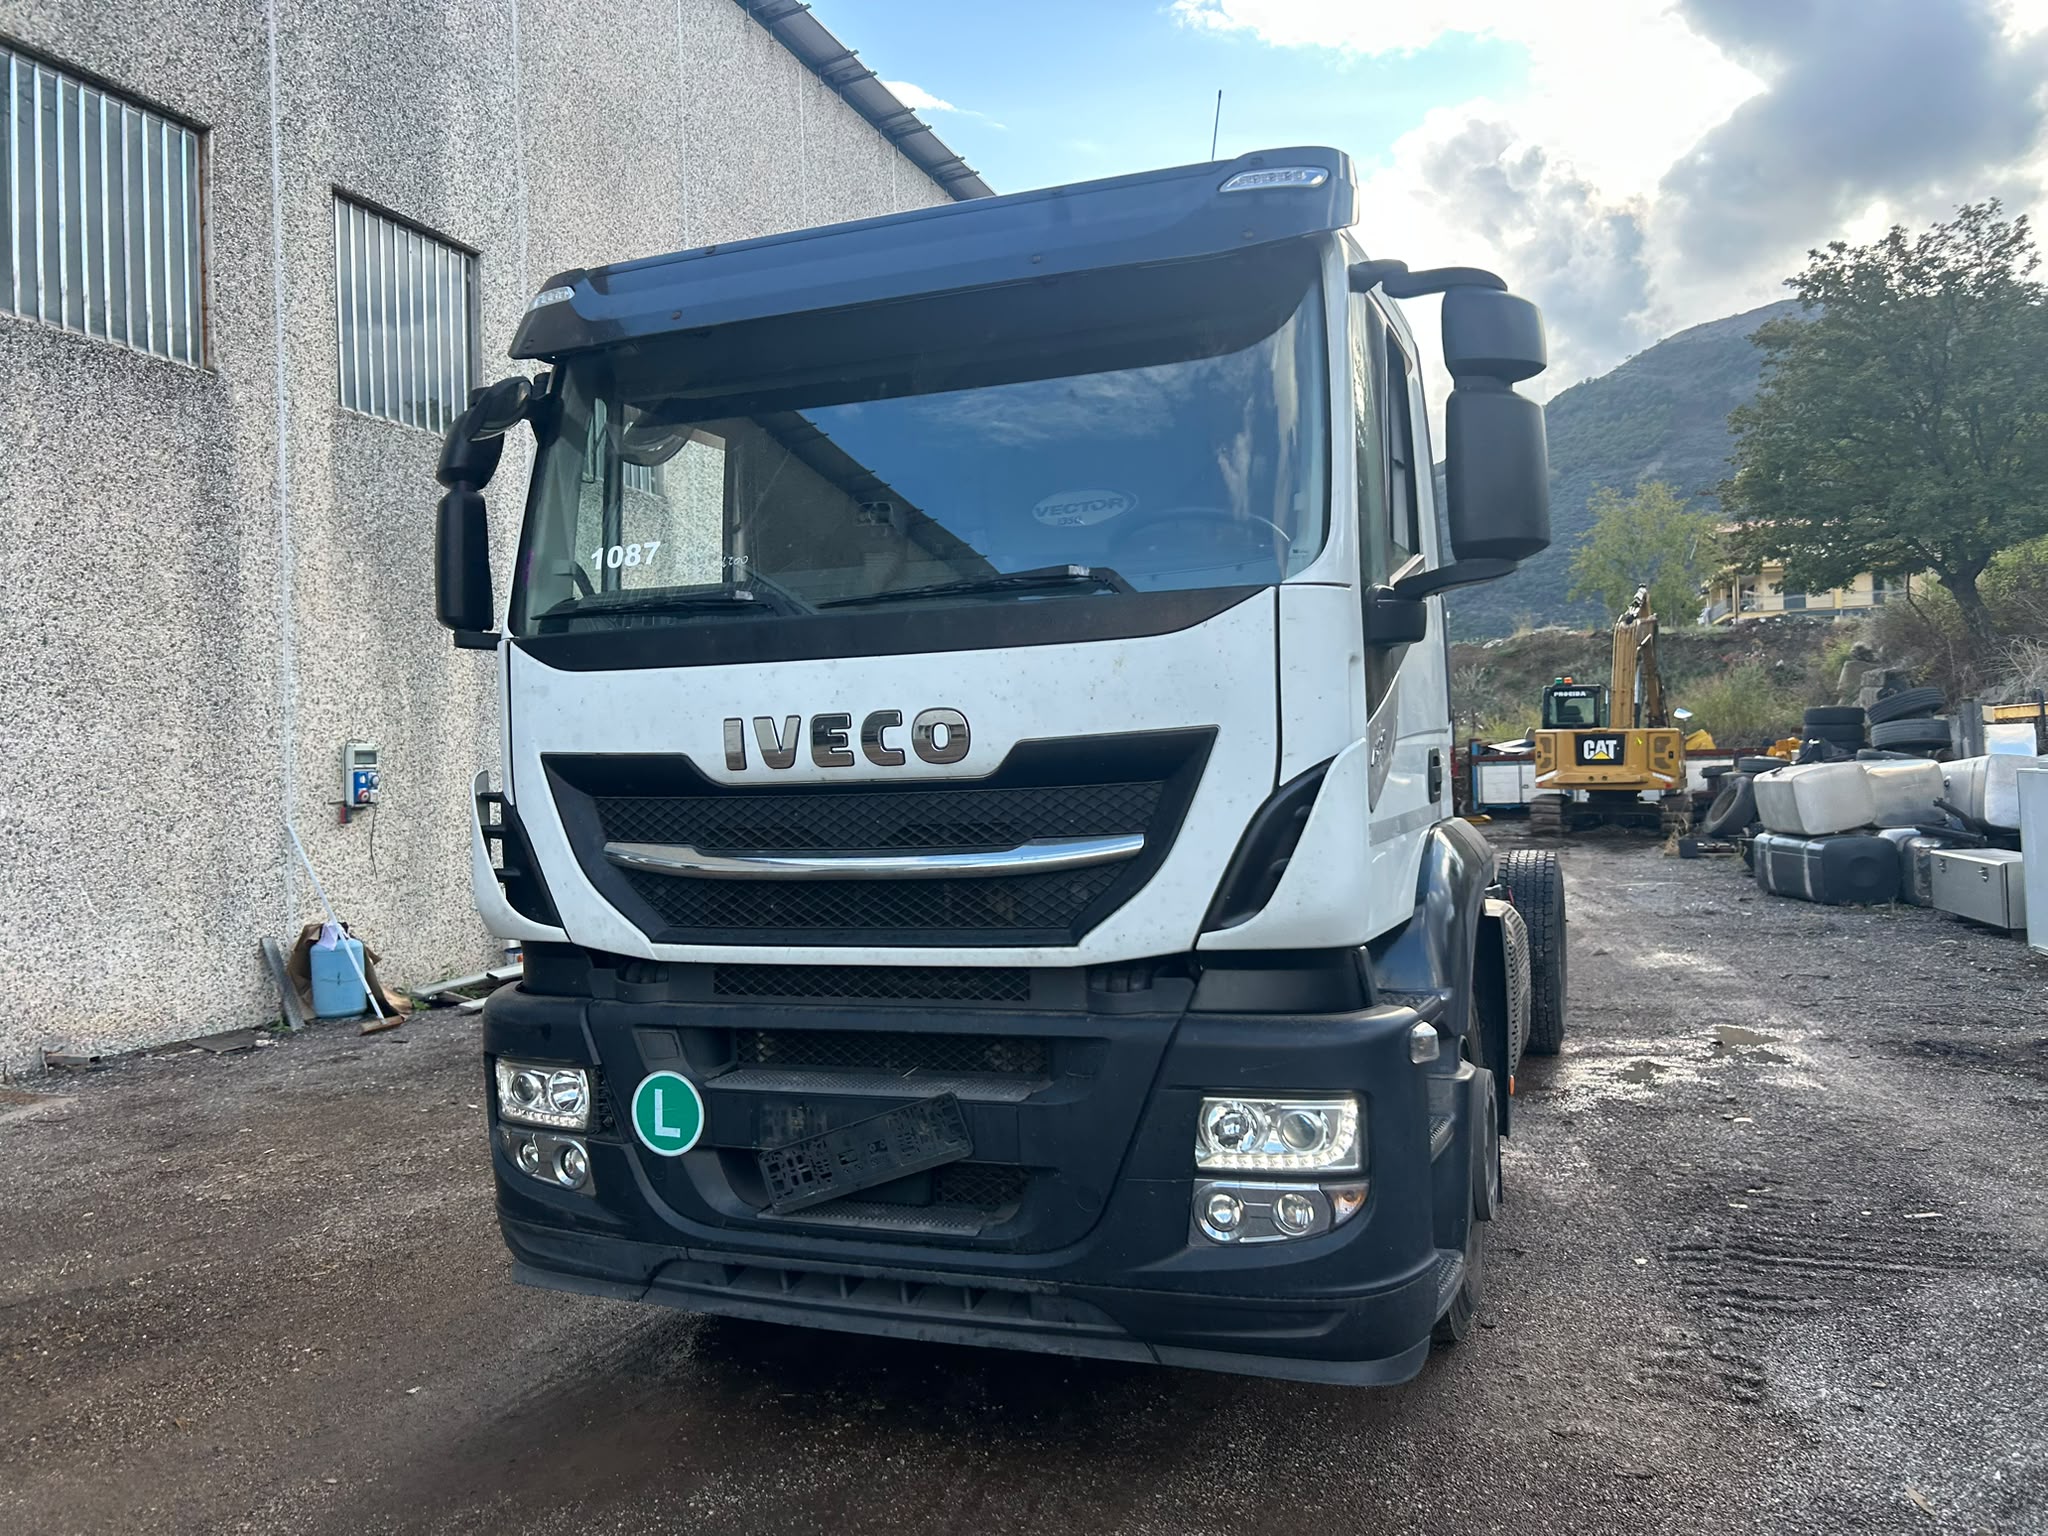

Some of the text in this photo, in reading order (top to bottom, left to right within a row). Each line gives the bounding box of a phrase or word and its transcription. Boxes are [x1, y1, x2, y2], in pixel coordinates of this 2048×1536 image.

[1034, 497, 1125, 518] VECTOR
[591, 541, 661, 570] 1087
[723, 707, 971, 771] IVECO
[1583, 740, 1617, 759] CAT
[654, 1088, 681, 1138] L
